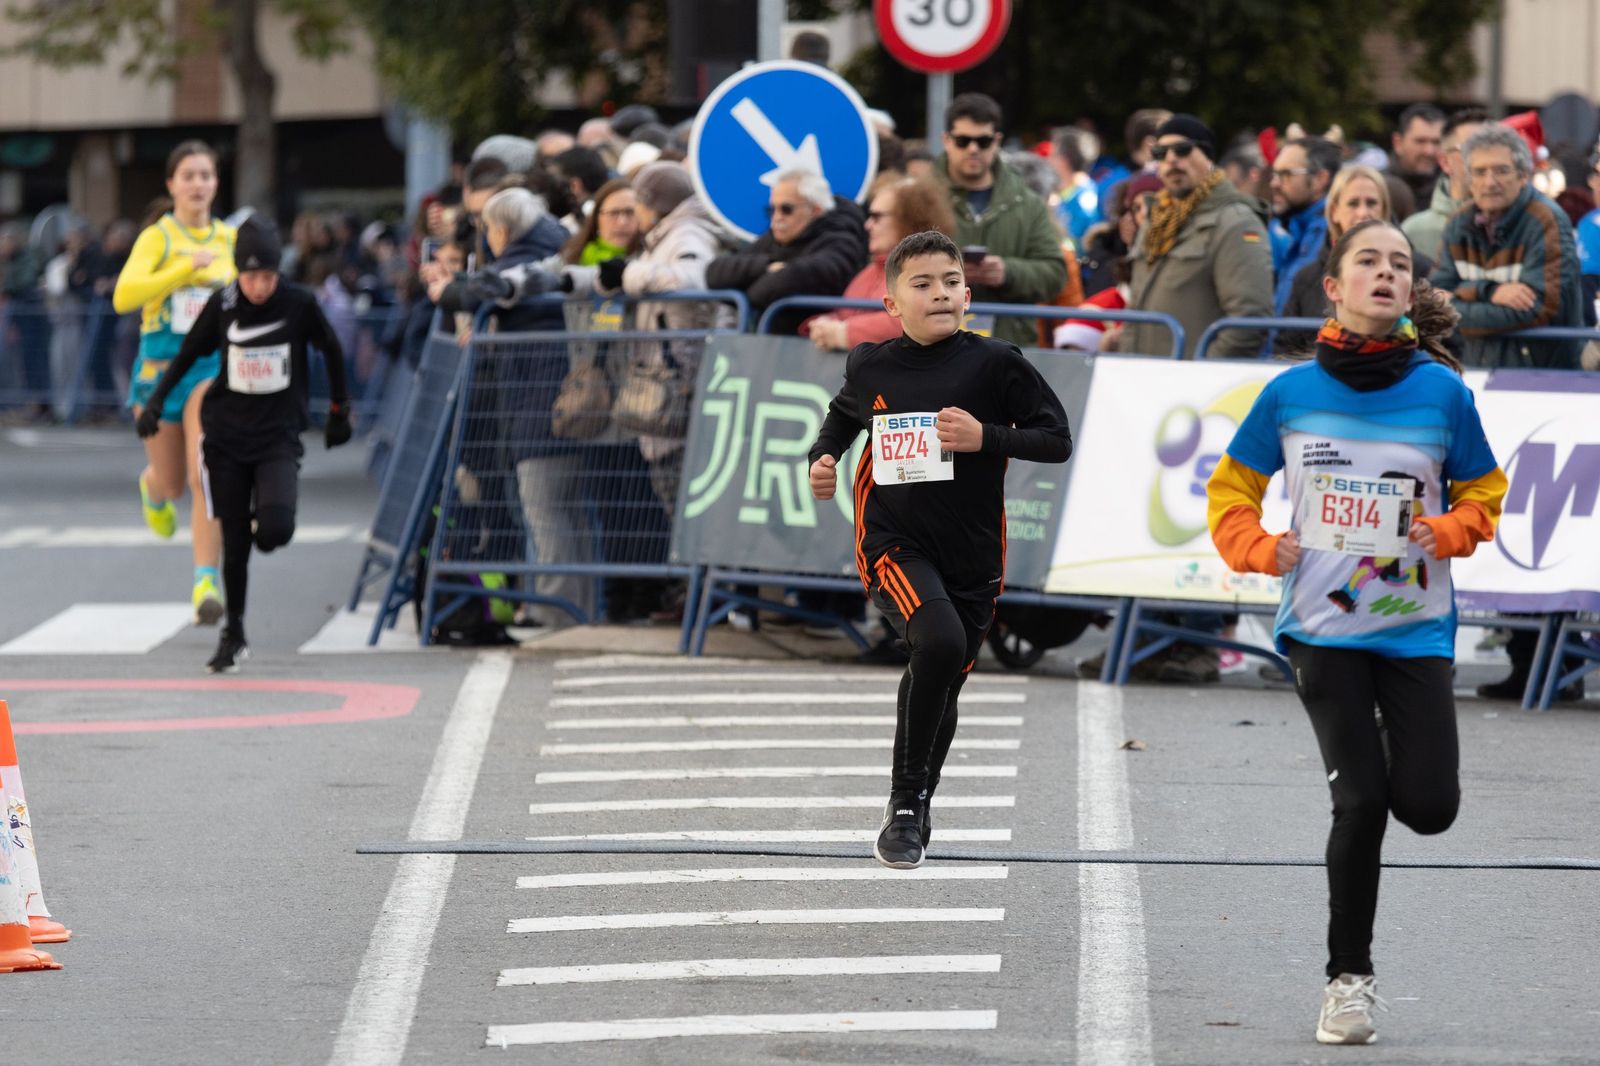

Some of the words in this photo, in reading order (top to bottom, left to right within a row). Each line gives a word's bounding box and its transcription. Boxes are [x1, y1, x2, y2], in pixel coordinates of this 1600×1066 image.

[907, 0, 975, 27] 30
[880, 431, 929, 461] 6224
[1333, 478, 1403, 496] SETEL
[1321, 493, 1381, 529] 6314
